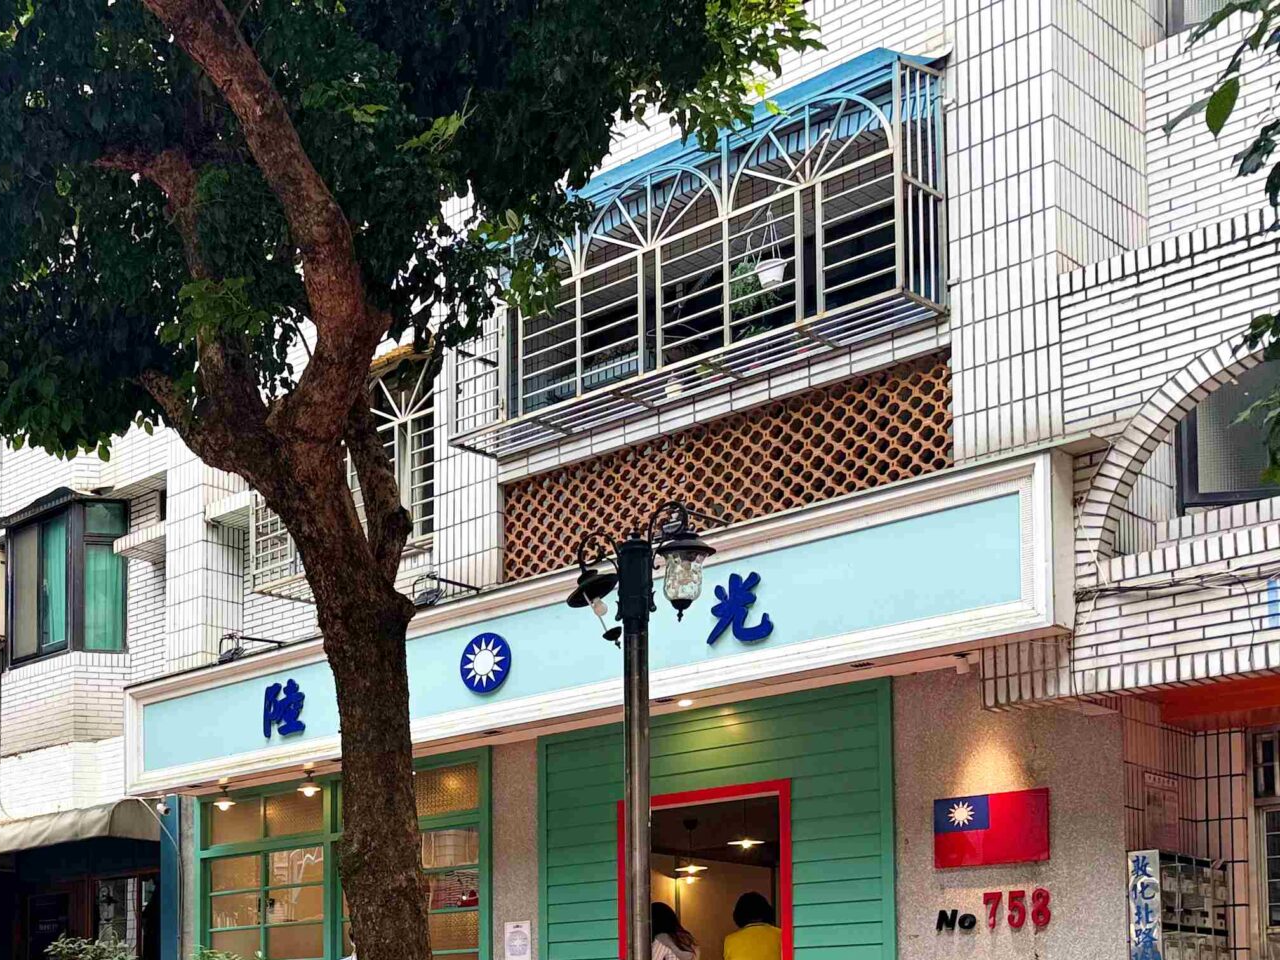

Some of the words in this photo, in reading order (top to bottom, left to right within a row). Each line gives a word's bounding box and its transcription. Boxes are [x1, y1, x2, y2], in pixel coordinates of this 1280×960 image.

[263, 678, 306, 738] 陸
[706, 571, 774, 647] 光
[936, 909, 977, 931] No
[983, 888, 1051, 930] 758
